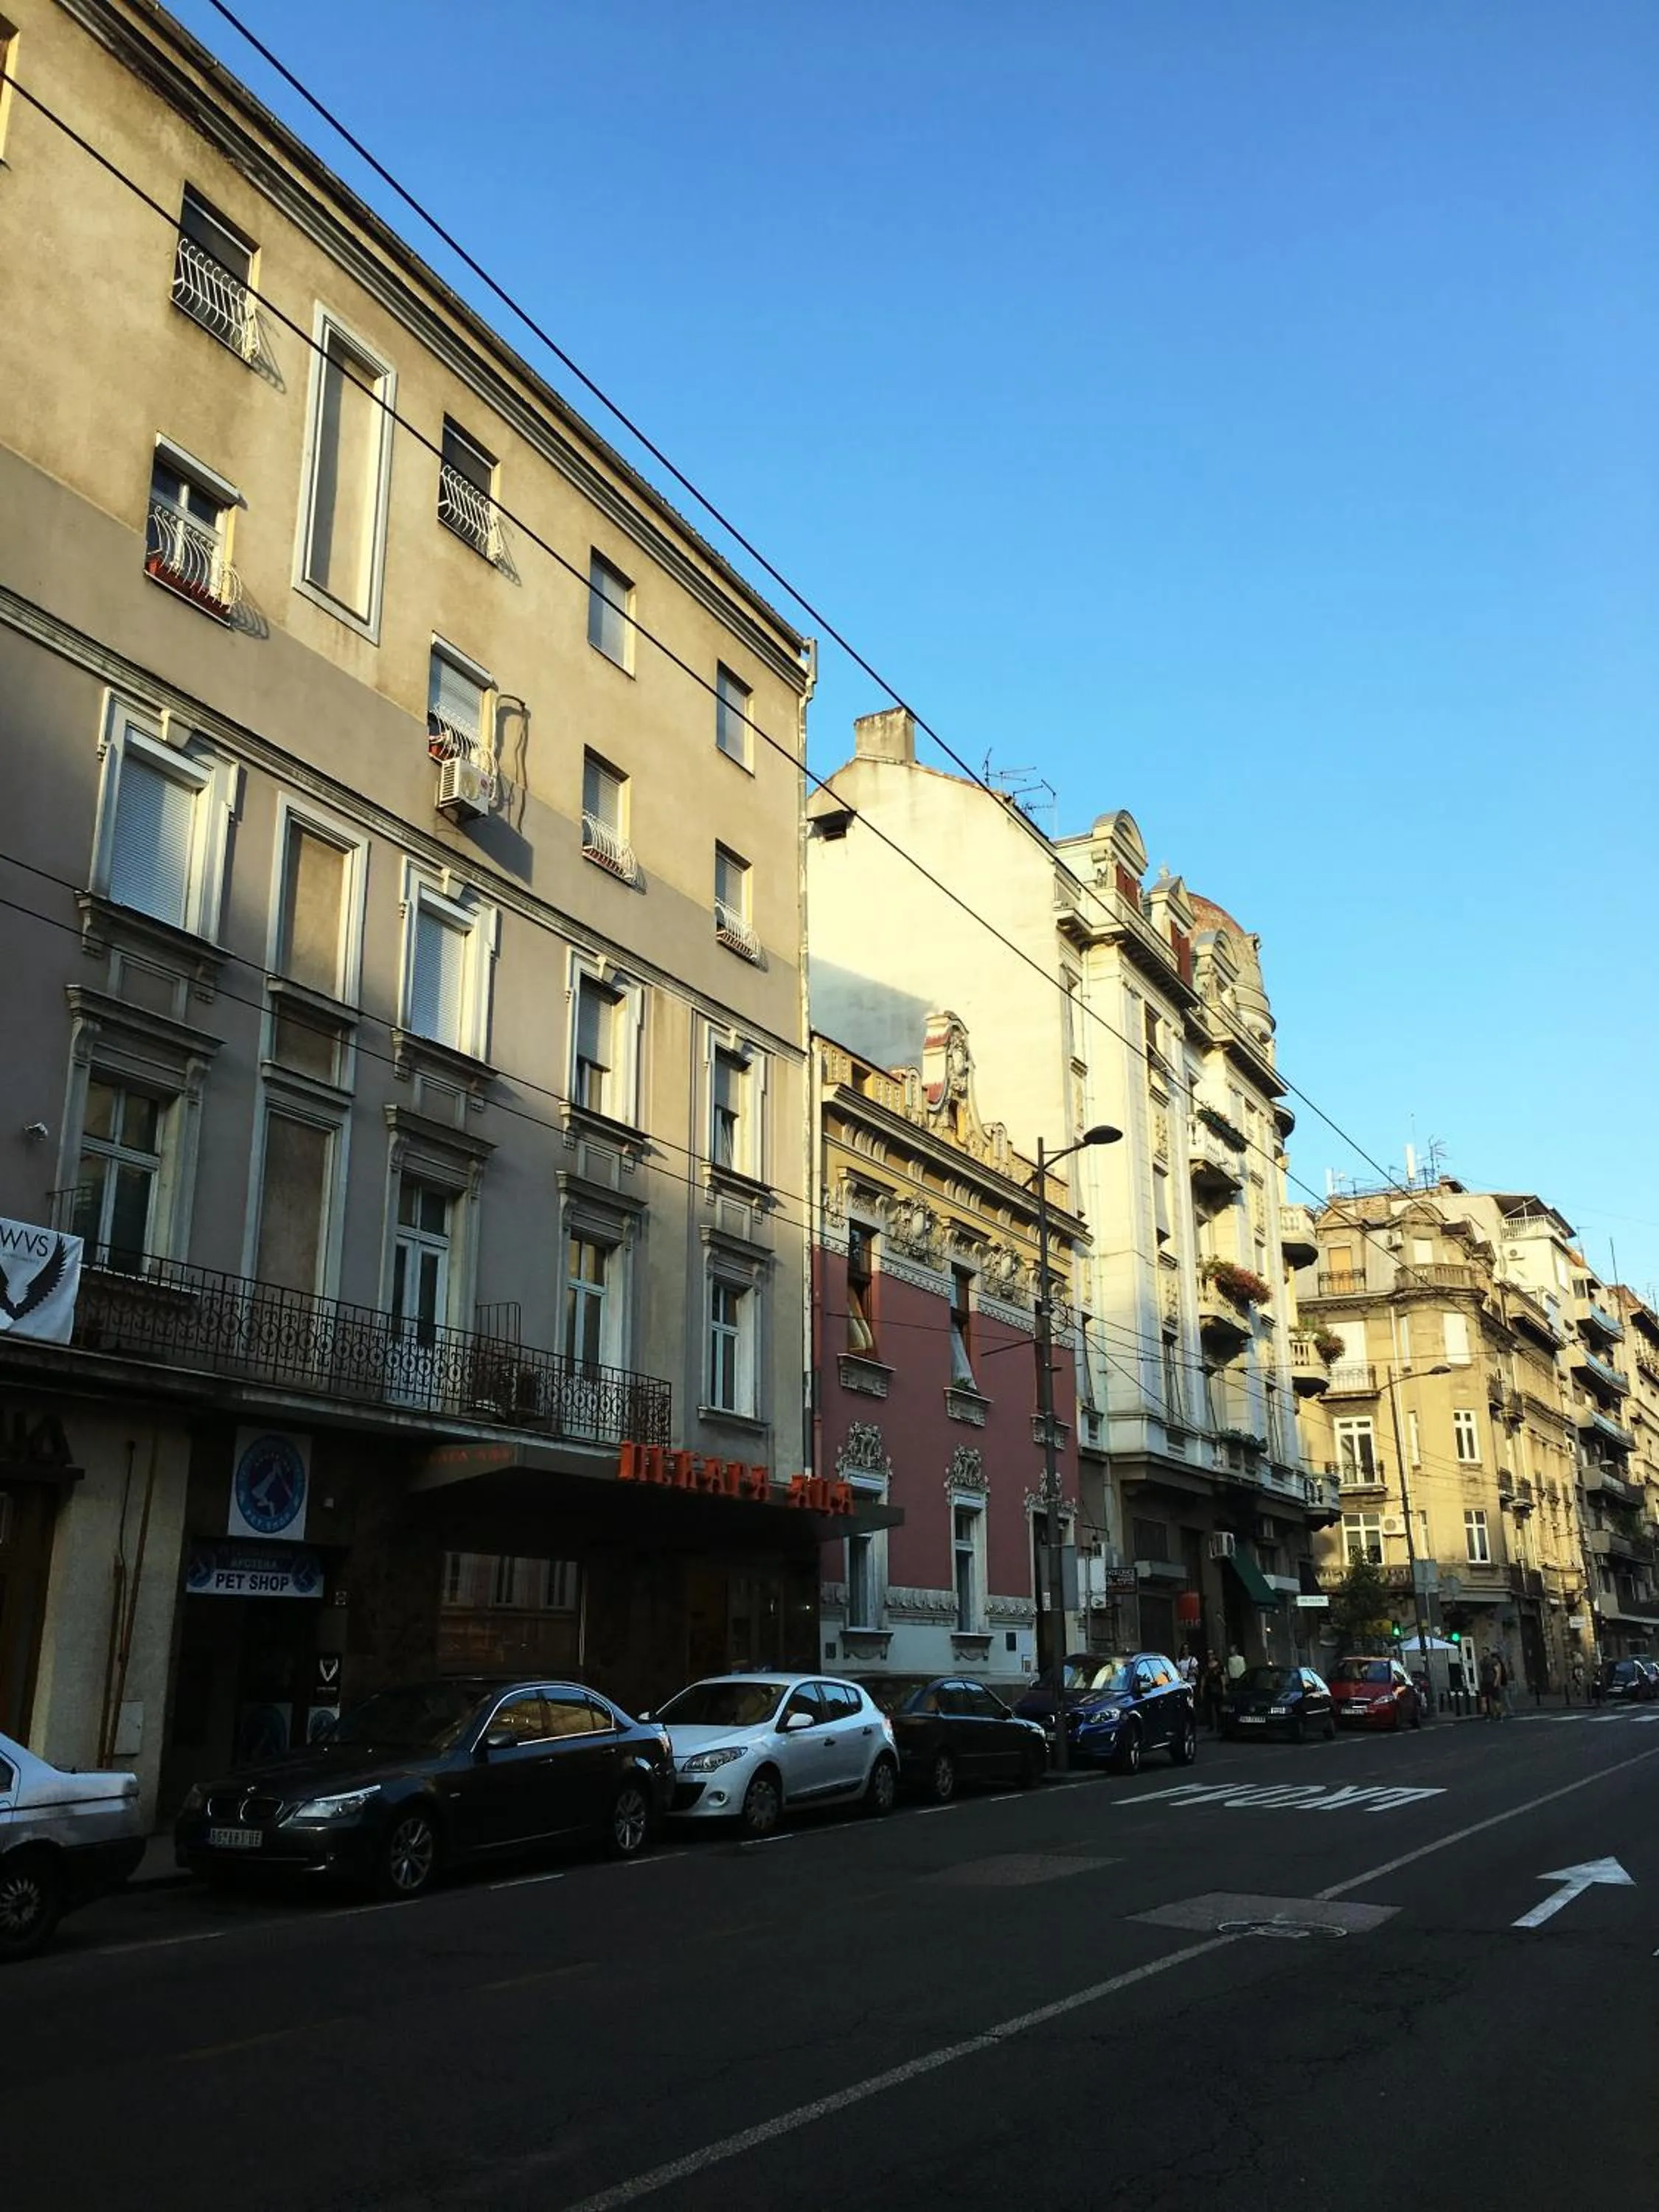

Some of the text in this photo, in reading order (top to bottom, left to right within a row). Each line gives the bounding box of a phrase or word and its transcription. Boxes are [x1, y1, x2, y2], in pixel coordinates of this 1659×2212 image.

[617, 1439, 855, 1517] ПЕКАРА АЦА
[215, 1573, 290, 1591] PET SHOP
